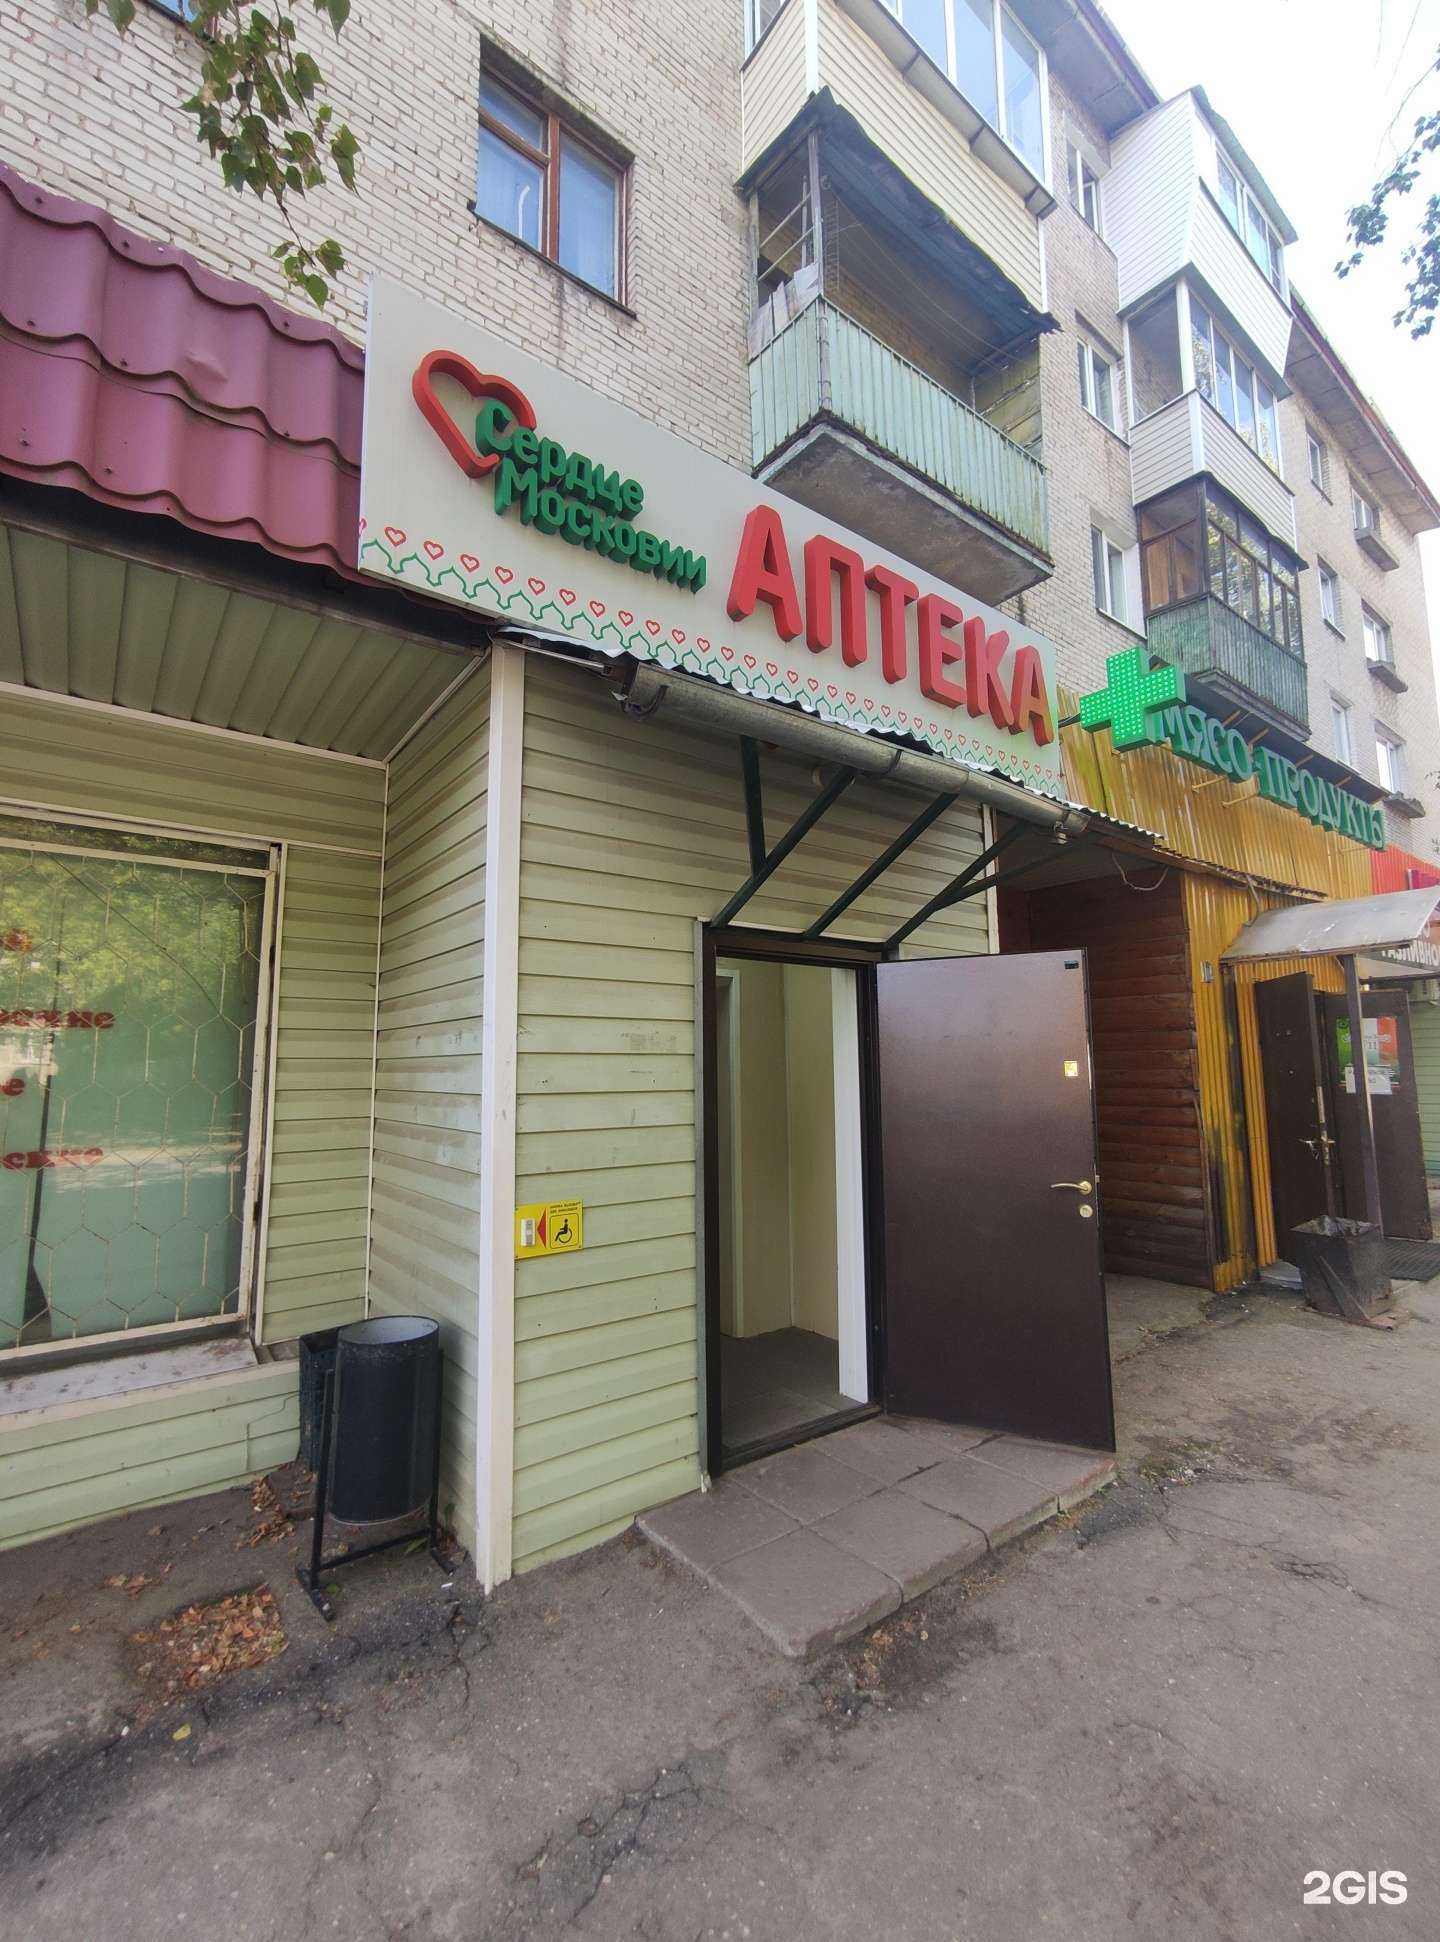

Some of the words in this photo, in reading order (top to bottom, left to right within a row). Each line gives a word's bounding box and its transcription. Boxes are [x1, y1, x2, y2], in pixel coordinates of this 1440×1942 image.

[476, 399, 645, 521] Сердце
[494, 457, 707, 593] Московии
[726, 504, 1055, 747] АПТЕКА
